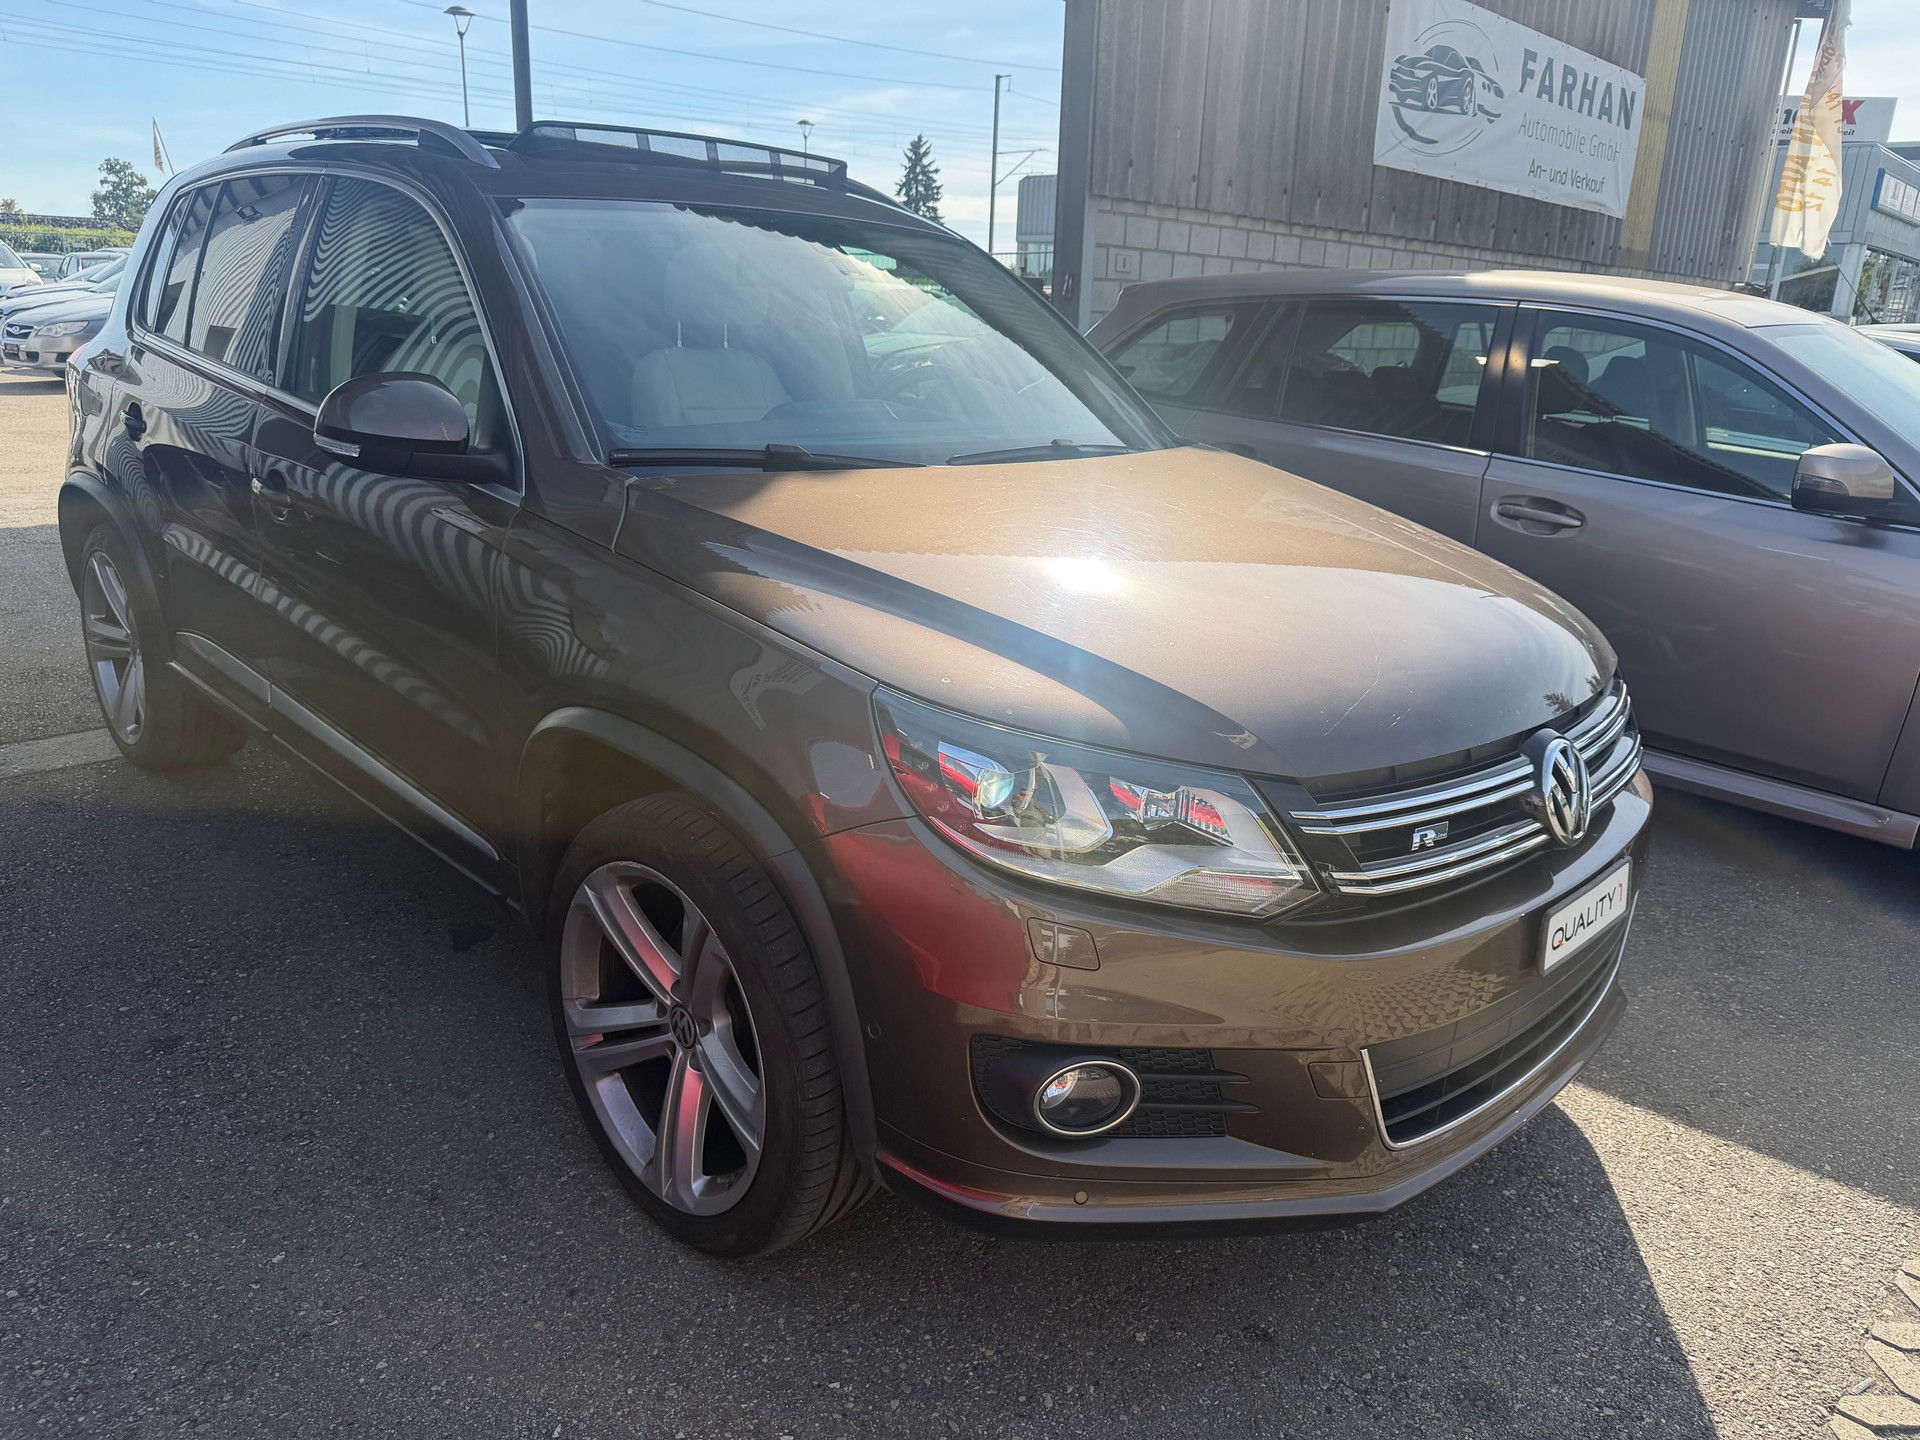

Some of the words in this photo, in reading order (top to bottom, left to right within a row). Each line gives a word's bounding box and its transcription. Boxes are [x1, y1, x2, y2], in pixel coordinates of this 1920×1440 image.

[1519, 47, 1636, 131] FARHAN
[1518, 112, 1586, 154] Automobile
[1589, 134, 1621, 163] GmbH
[1528, 158, 1547, 179] An-
[1549, 167, 1569, 185] und
[1571, 169, 1605, 194] Verkauf
[1551, 887, 1617, 951] QUALITY
[1618, 882, 1624, 902] 1
